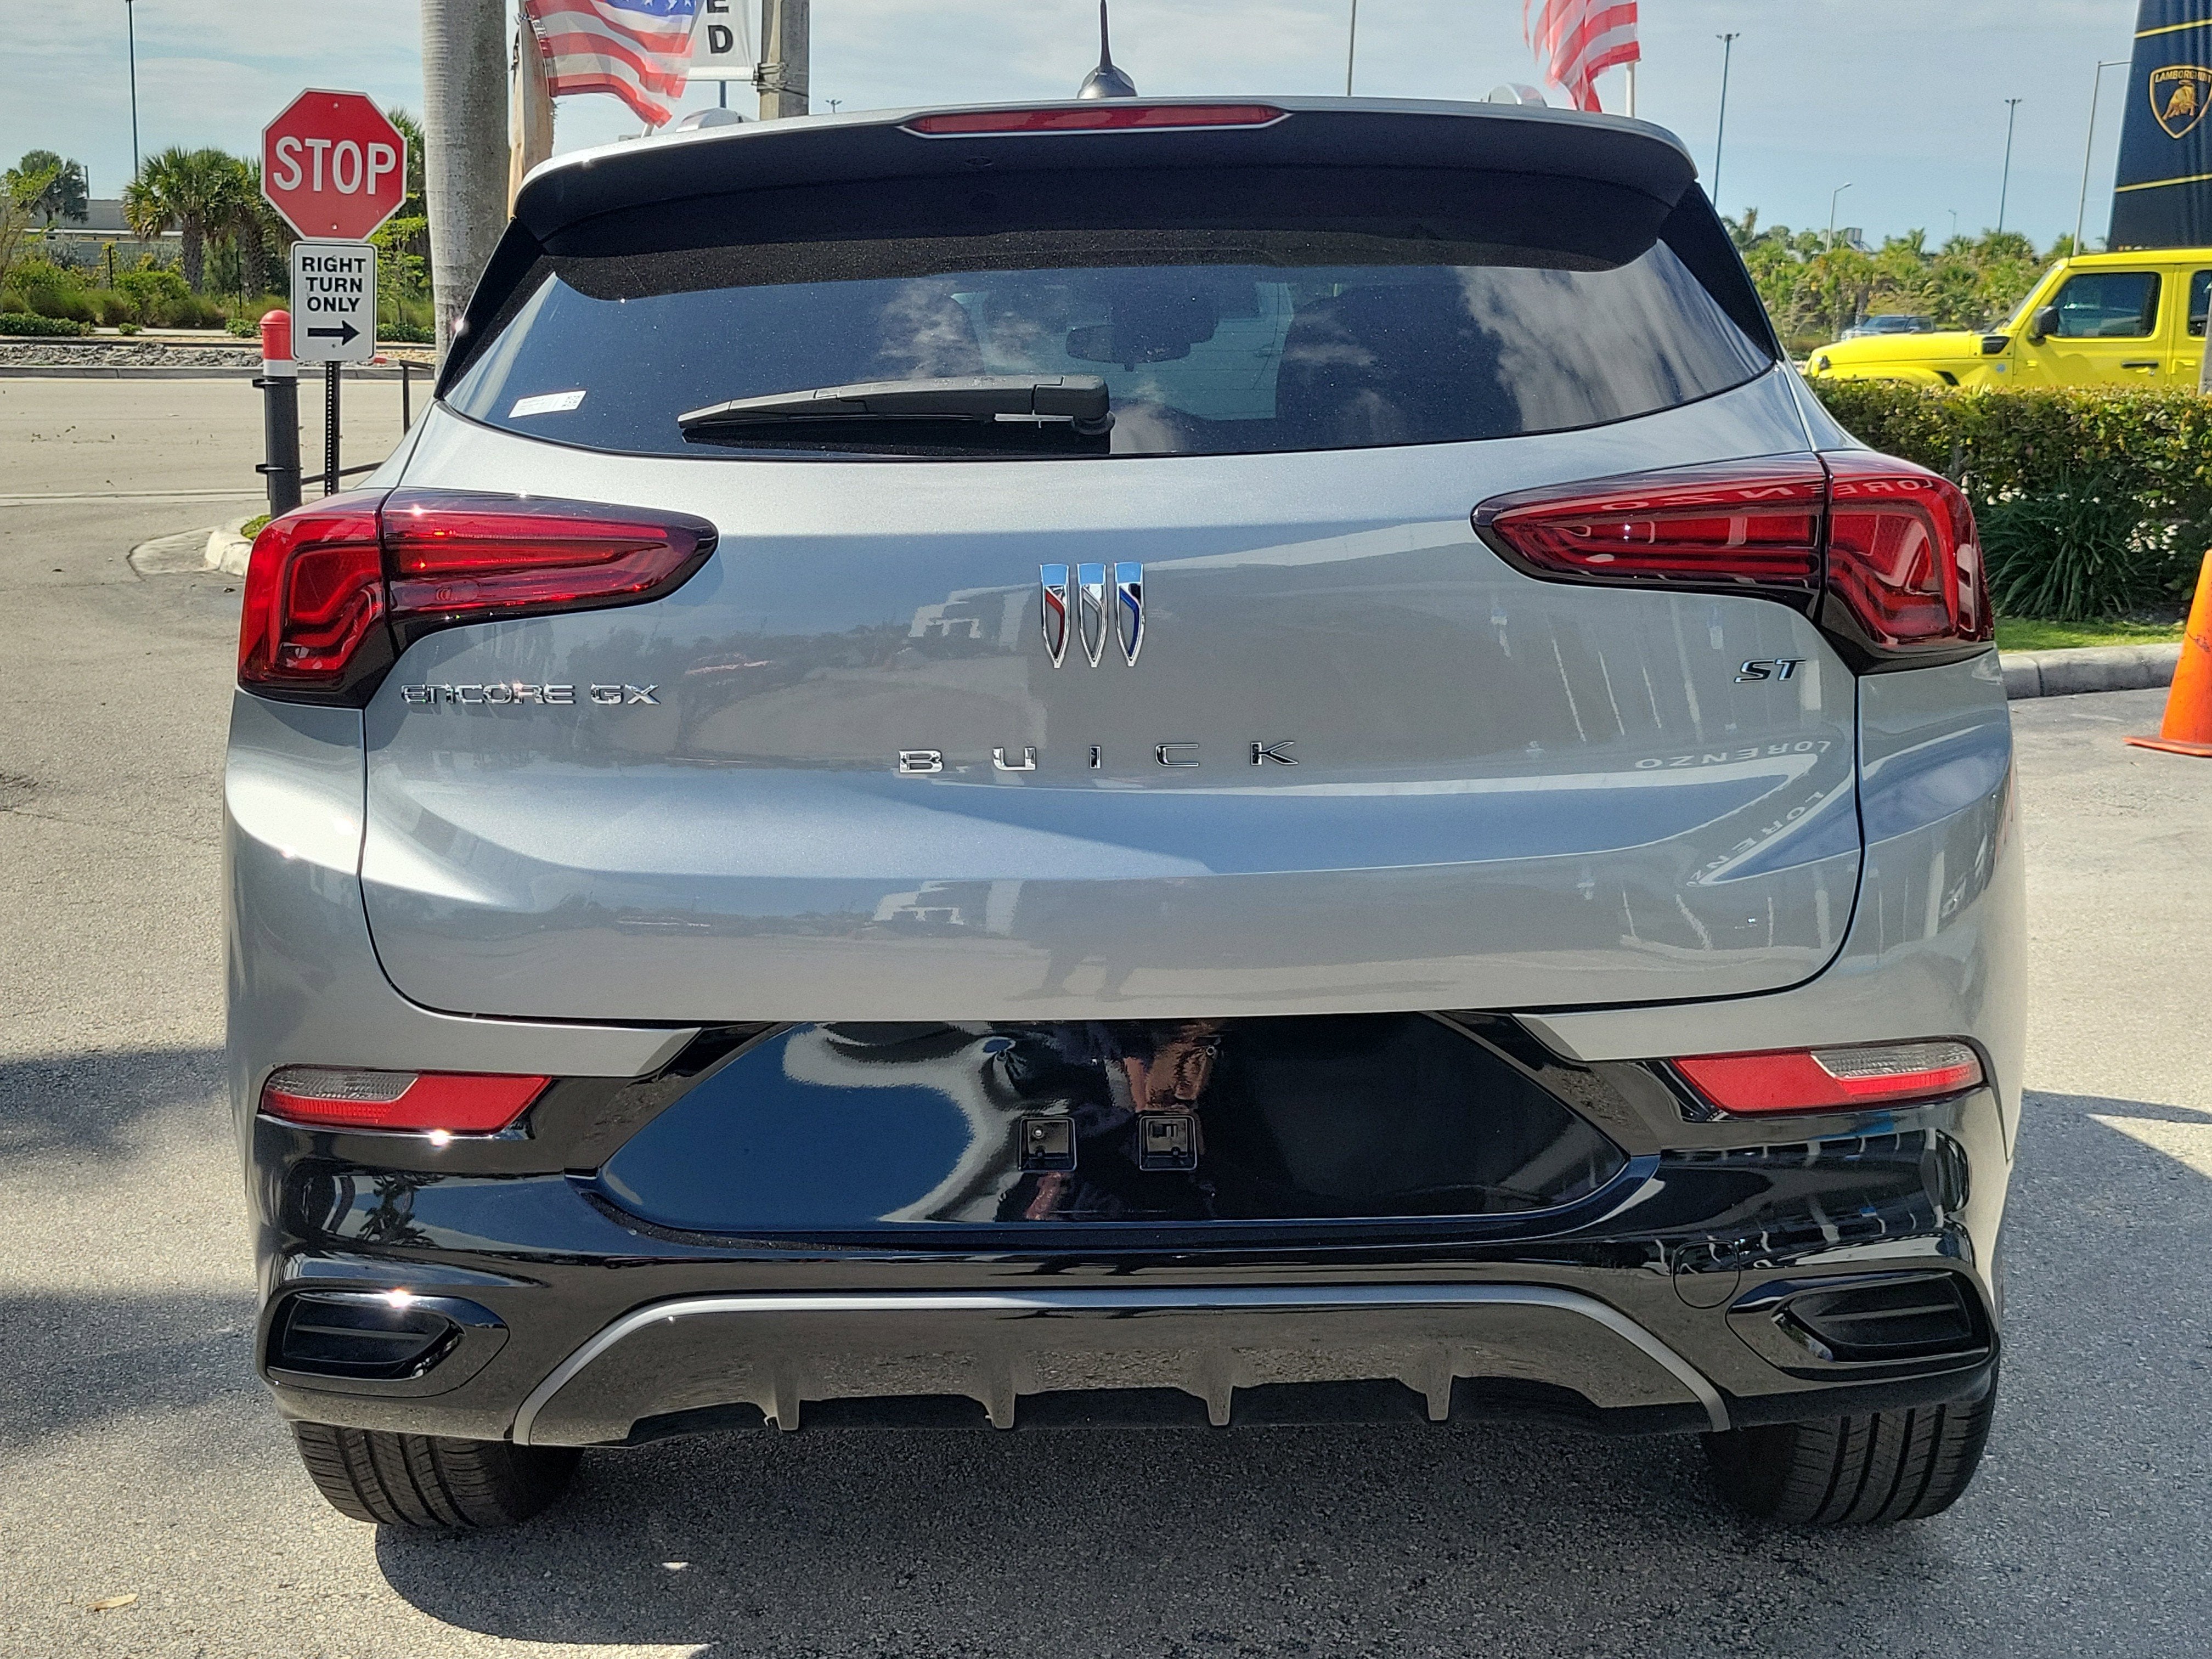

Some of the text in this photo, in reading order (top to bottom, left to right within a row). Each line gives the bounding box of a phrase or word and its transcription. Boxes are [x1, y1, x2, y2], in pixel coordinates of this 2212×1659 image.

[273, 136, 396, 195] STOP
[302, 256, 366, 274] RIGHT
[306, 276, 363, 294] TURN
[307, 296, 361, 313] ONLY
[1734, 658, 1807, 683] ST
[400, 682, 661, 705] ENCORE GX
[899, 741, 1299, 773] BUICK
